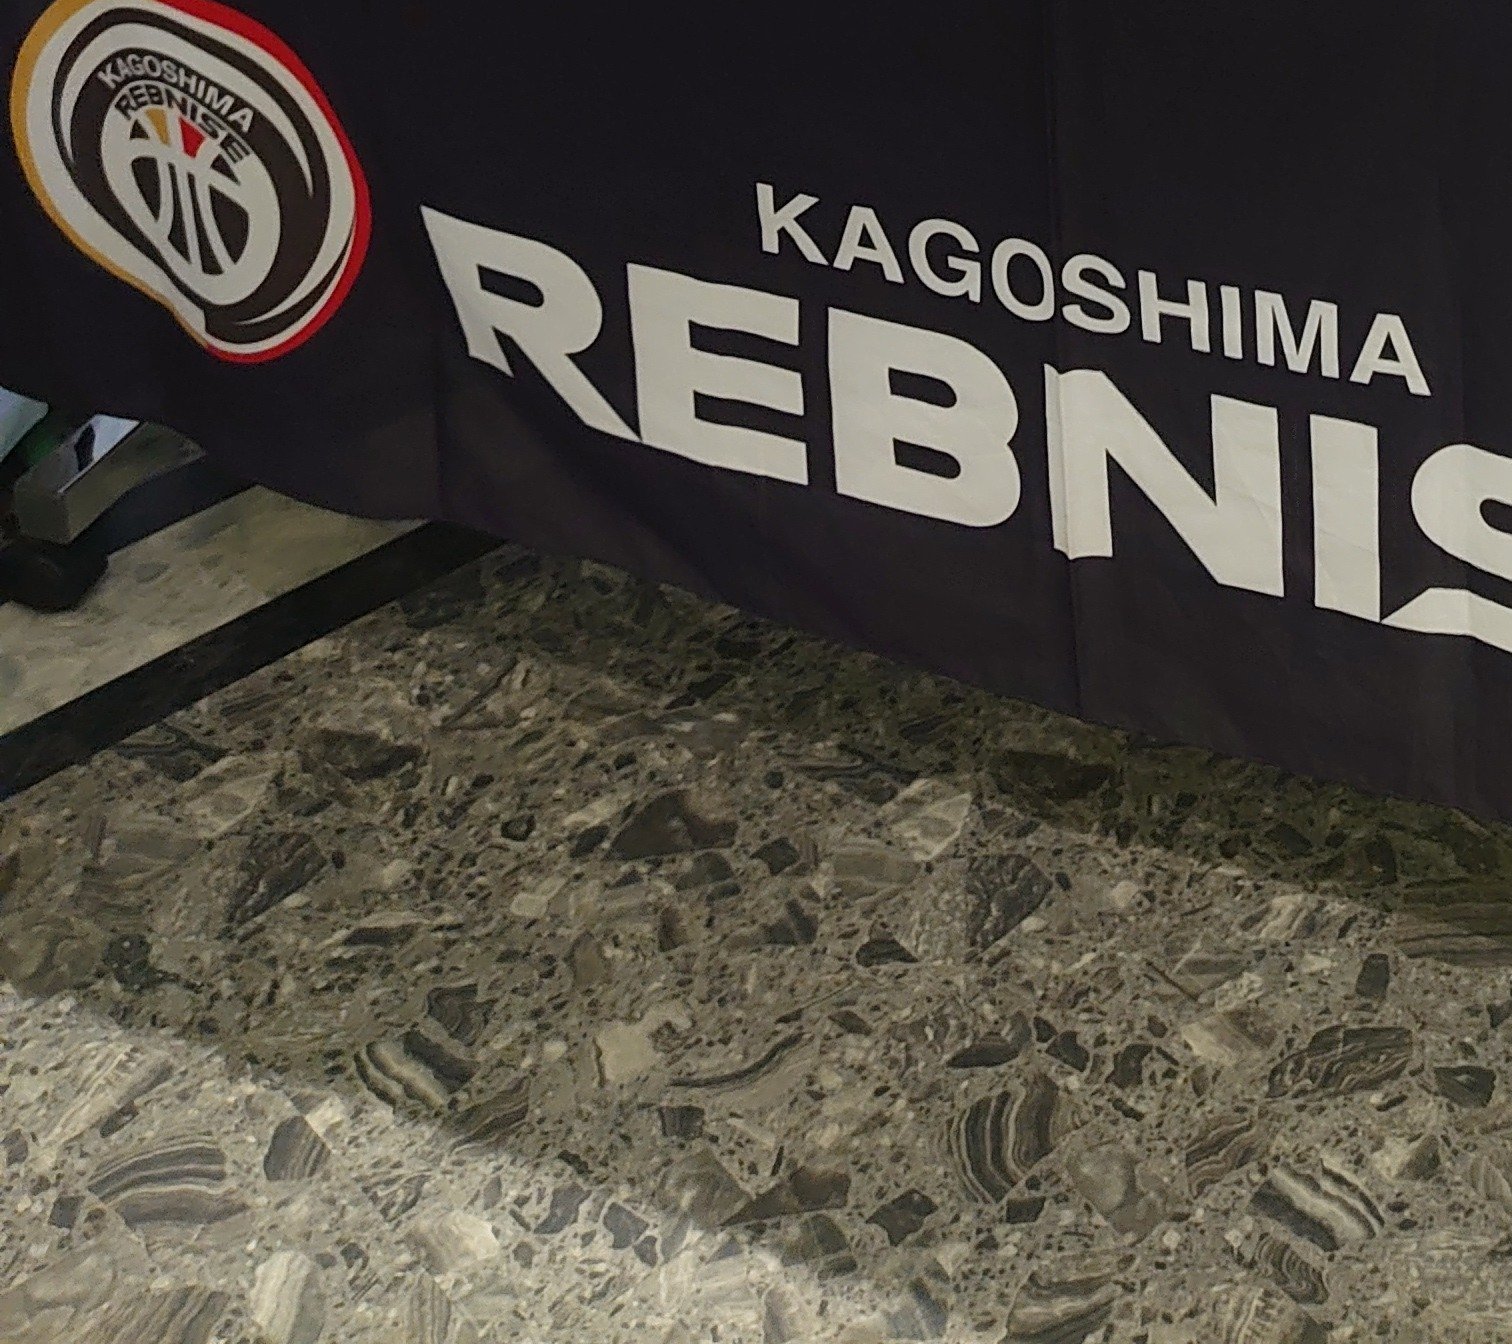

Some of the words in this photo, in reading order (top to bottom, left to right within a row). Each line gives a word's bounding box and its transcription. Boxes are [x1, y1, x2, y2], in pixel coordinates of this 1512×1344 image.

[98, 53, 256, 133] KAGOSHIMA
[114, 84, 251, 165] REBNISE
[755, 182, 1430, 398] KAGOSHIMA
